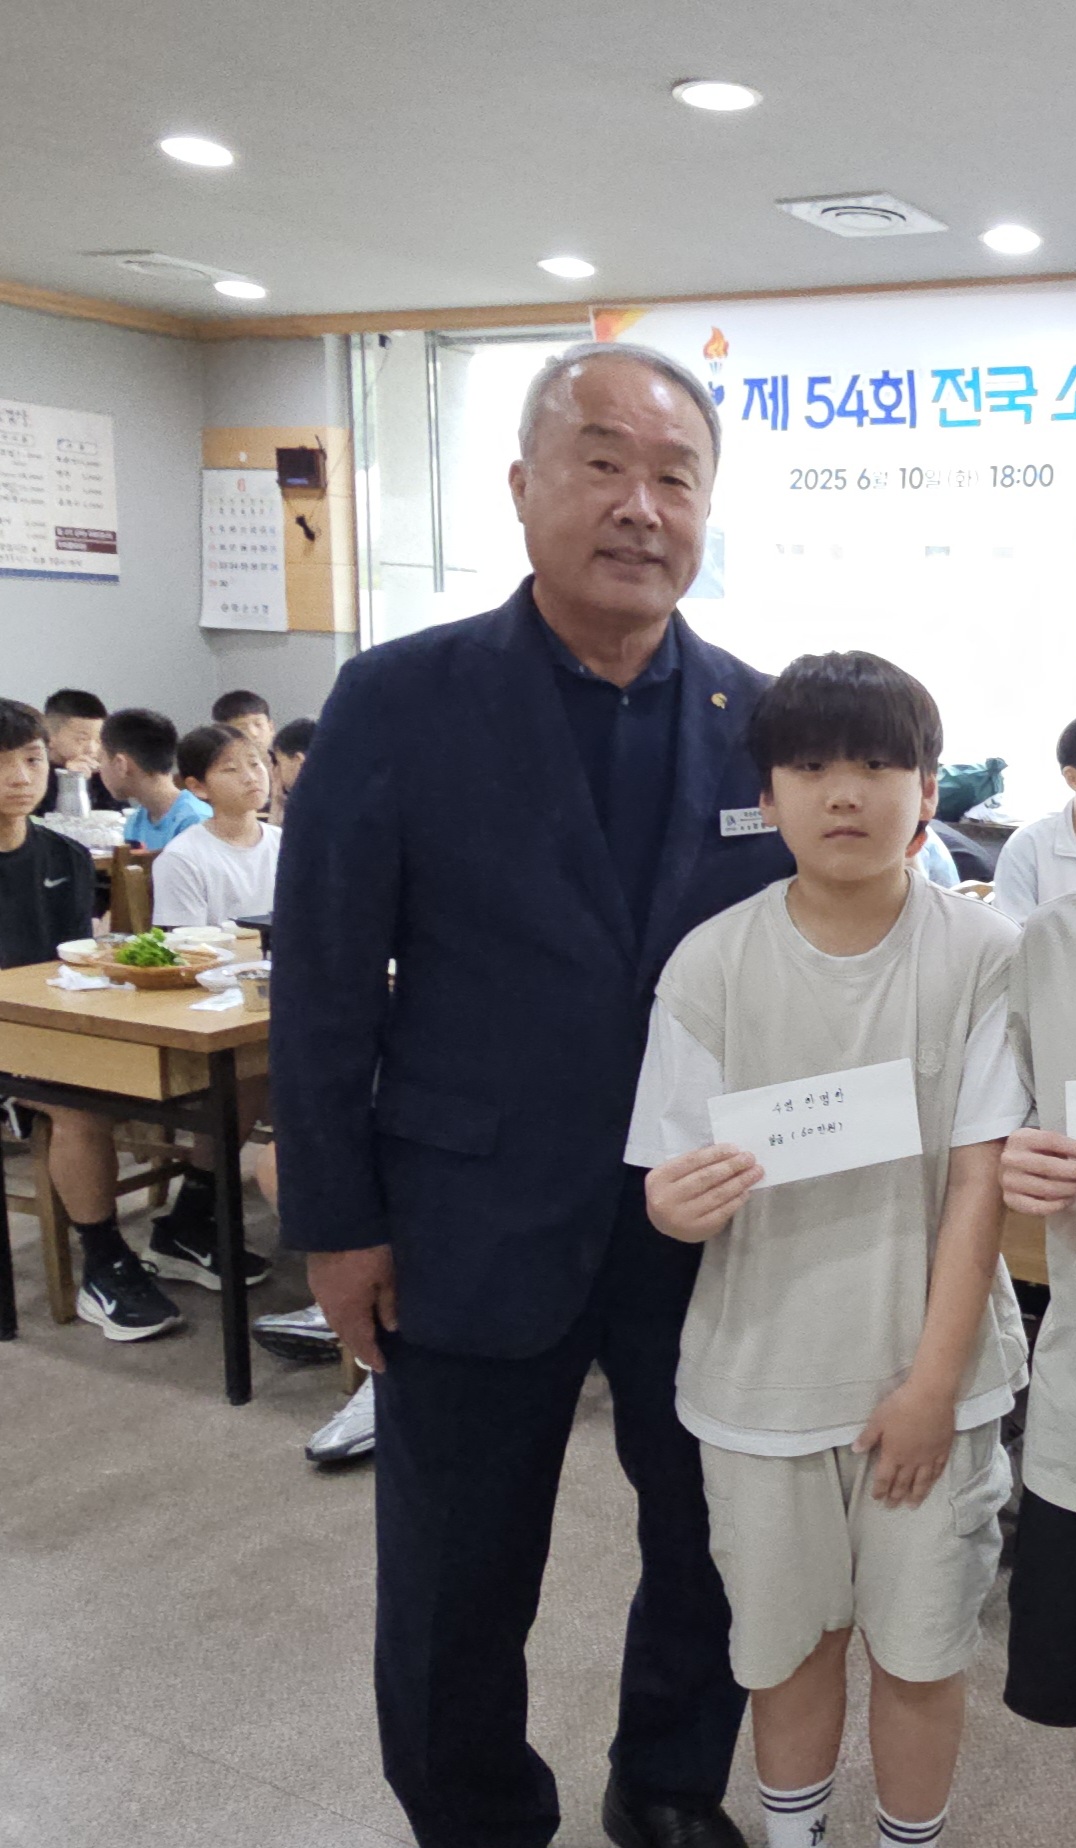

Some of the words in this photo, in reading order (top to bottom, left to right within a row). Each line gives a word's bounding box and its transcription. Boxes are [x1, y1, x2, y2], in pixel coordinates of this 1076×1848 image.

[741, 375, 789, 430] 제
[805, 370, 917, 429] 54회
[930, 365, 1039, 428] 전국
[789, 468, 847, 490] 2025
[857, 468, 888, 490] 6월
[989, 463, 1054, 488] 18:00
